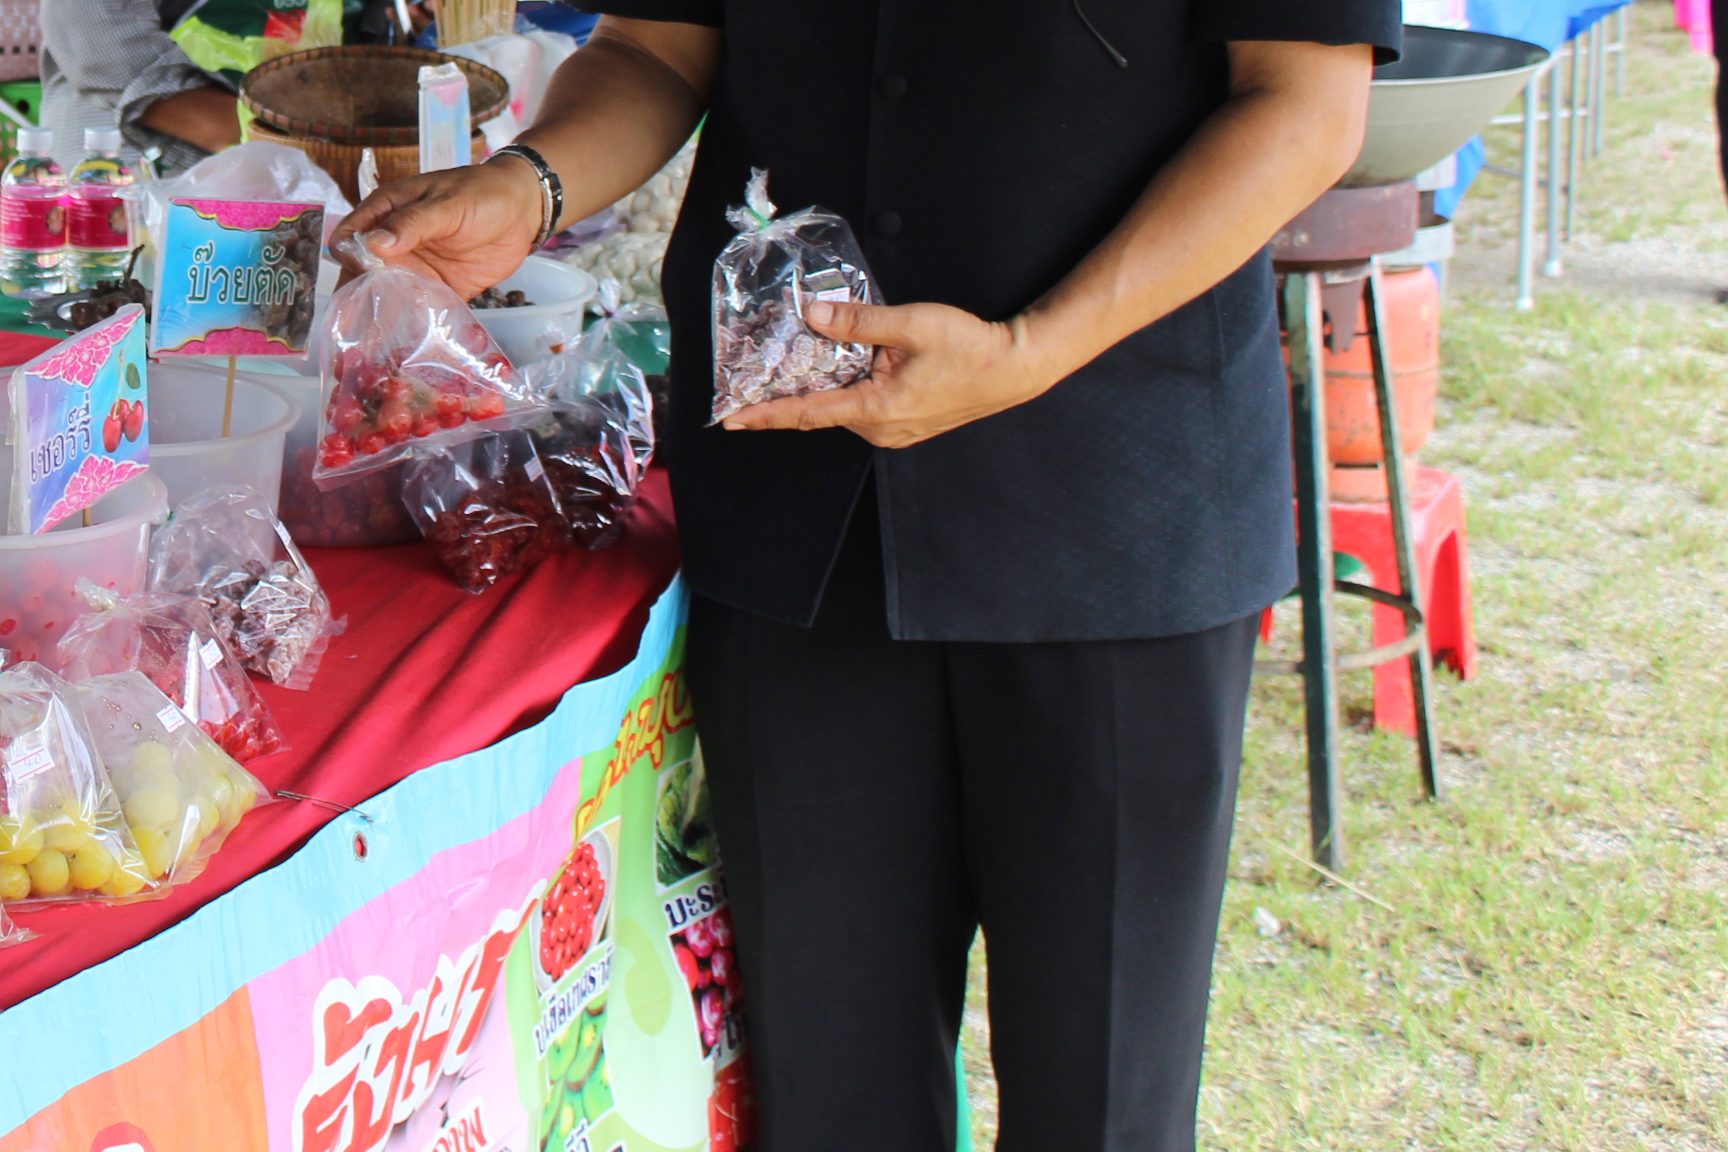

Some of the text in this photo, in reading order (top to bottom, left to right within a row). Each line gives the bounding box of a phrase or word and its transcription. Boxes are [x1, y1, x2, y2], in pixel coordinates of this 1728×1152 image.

[186, 242, 297, 305] บ๊วยตัด
[28, 392, 92, 484] เชอร์รี่
[23, 751, 42, 771] 40
